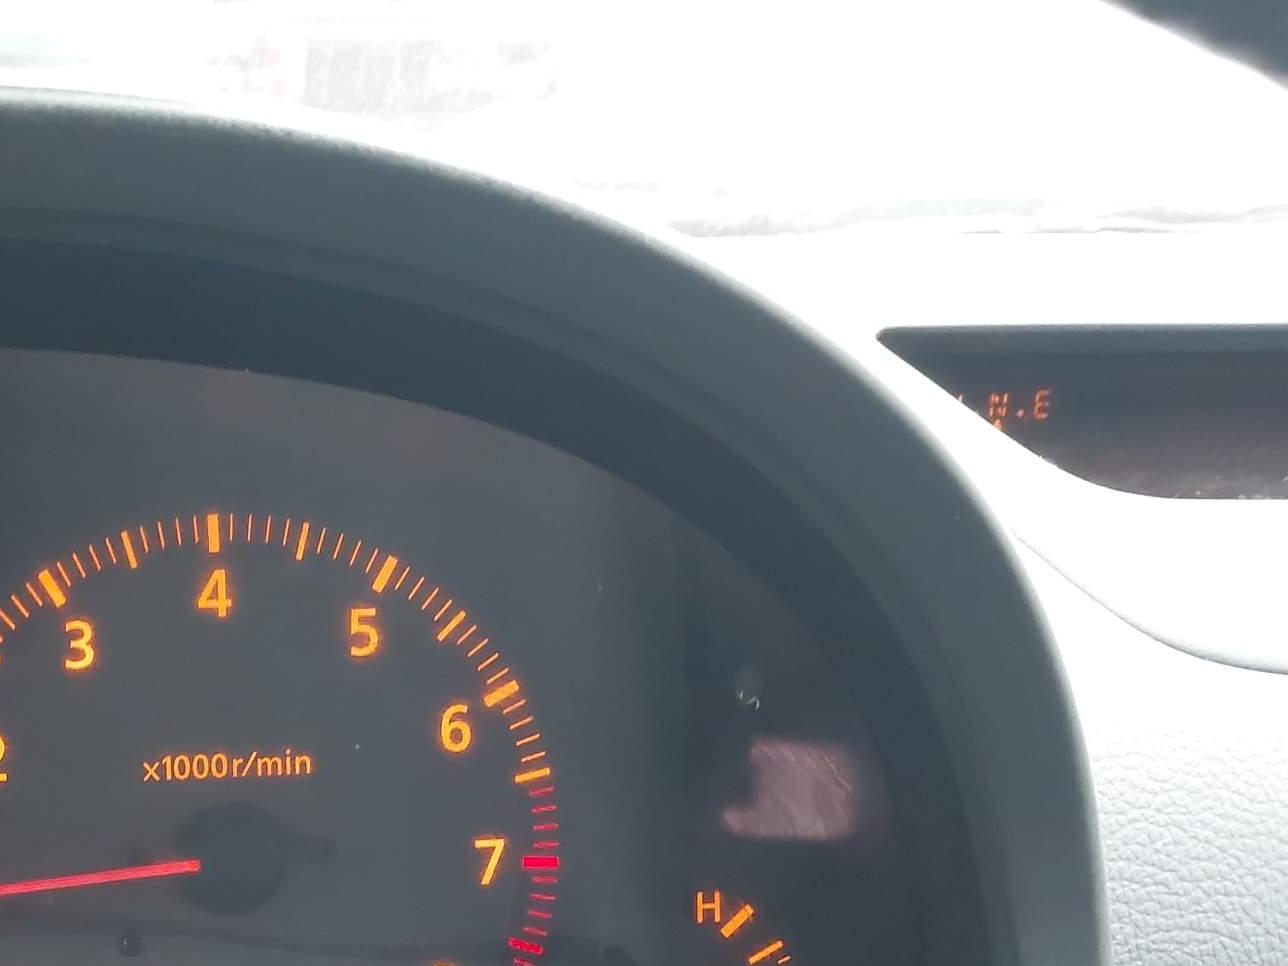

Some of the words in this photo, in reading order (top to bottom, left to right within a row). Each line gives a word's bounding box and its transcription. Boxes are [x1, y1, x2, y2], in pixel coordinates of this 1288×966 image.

[196, 568, 232, 617] 4
[64, 619, 96, 670] 3
[348, 607, 380, 657] 5
[440, 703, 472, 752] 6
[474, 837, 505, 886] 7
[696, 890, 721, 923] H
